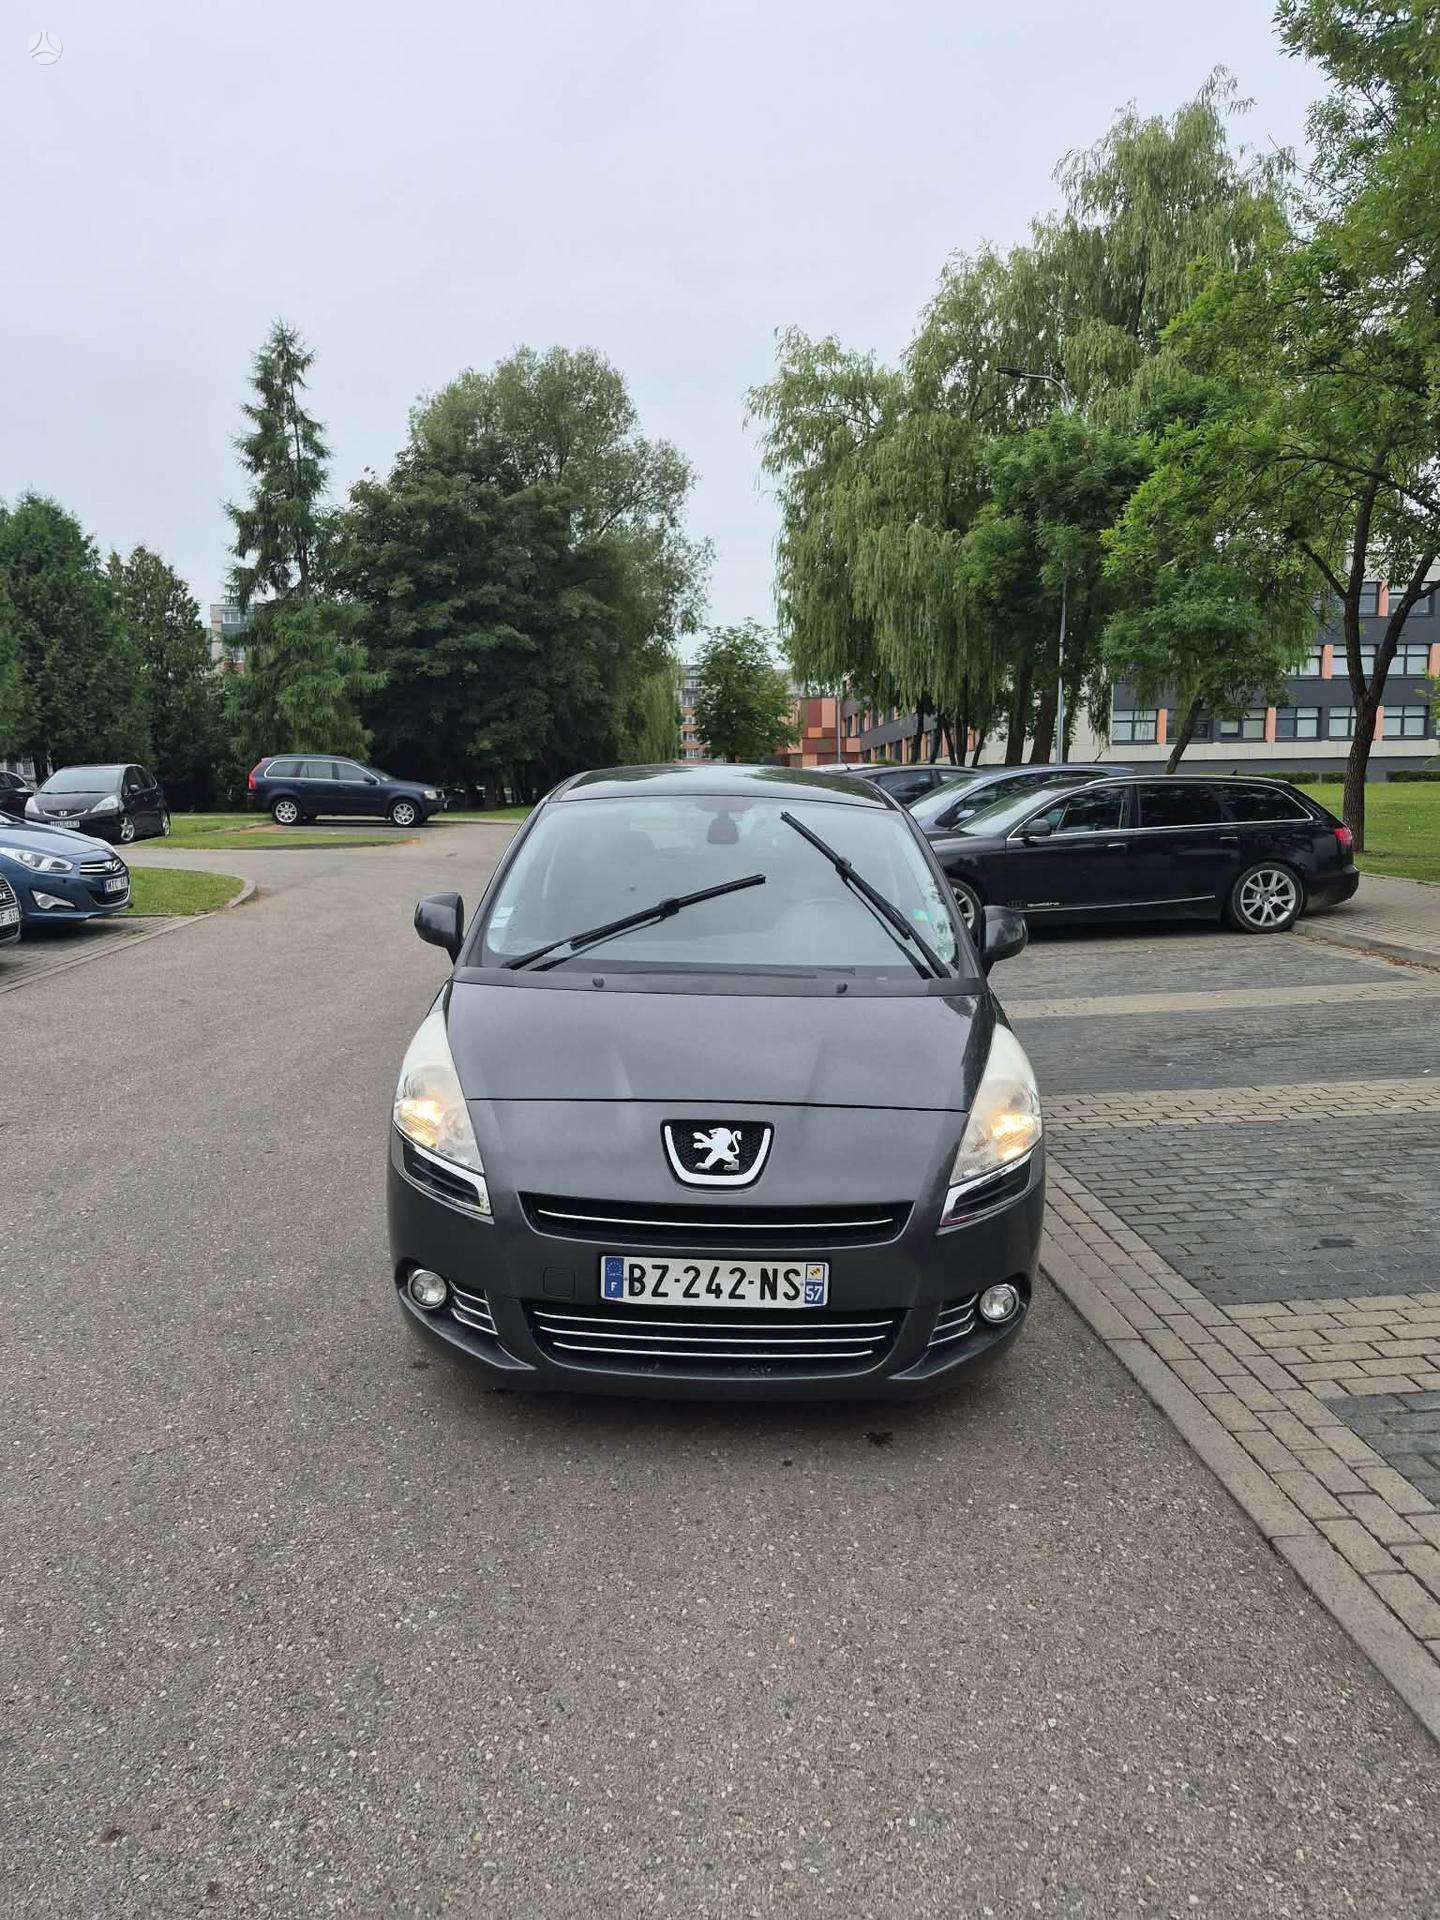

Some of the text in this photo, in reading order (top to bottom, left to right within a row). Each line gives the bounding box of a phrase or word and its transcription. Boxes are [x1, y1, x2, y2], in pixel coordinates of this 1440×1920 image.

[610, 1282, 618, 1292] F
[628, 1263, 801, 1301] BZ-242-NS
[806, 1285, 823, 1301] 57
